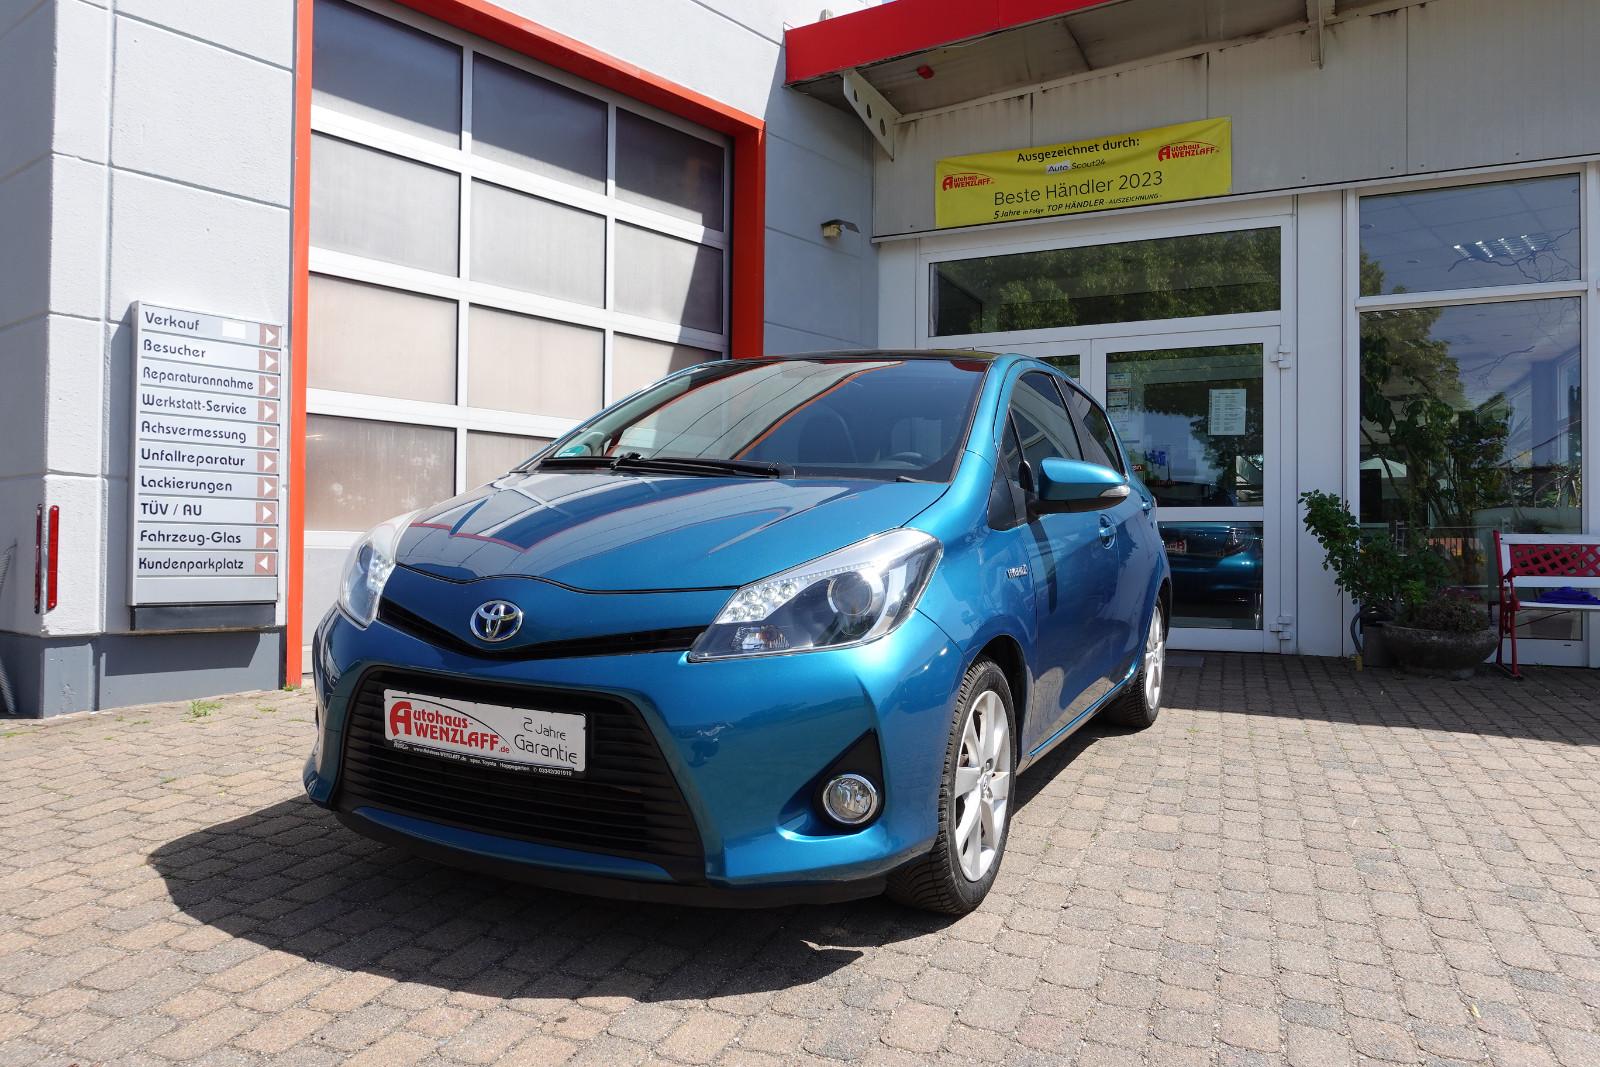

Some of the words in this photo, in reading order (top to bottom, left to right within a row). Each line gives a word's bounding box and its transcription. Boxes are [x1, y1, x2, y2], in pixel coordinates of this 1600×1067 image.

[1017, 143, 1100, 163] Ausgezeichnet
[1102, 137, 1140, 151] durch:
[1171, 147, 1215, 158] WENZLAFF
[1047, 164, 1069, 174] Auto
[1071, 158, 1106, 170] Scout24
[954, 177, 991, 189] WENZLAFF
[994, 189, 1041, 206] Beste
[1046, 178, 1114, 200] Händler
[1119, 170, 1163, 191] 2023
[993, 210, 1000, 220] 5
[1000, 209, 1021, 218] Jahre
[1047, 204, 1063, 212] TOP
[1065, 199, 1105, 210] HÄNDLER
[1109, 193, 1159, 205] AUSZEICHNUNG
[144, 311, 200, 331] Verkauf
[143, 338, 206, 358] Besucher
[143, 366, 254, 390] Reparaturannahme
[142, 393, 247, 415] Werkstatt-Service
[141, 420, 246, 444] Achsvermessung
[141, 448, 246, 467] Unfallreparatur
[141, 475, 233, 494] Lackierungen
[140, 500, 169, 516] TÜV
[183, 504, 202, 516] AU
[140, 530, 241, 546] Fahrzeug-Glas
[138, 557, 244, 573] Kundenparkplatz
[523, 716, 533, 733] 2
[535, 723, 567, 741] Jahre
[514, 734, 577, 765] Garantie
